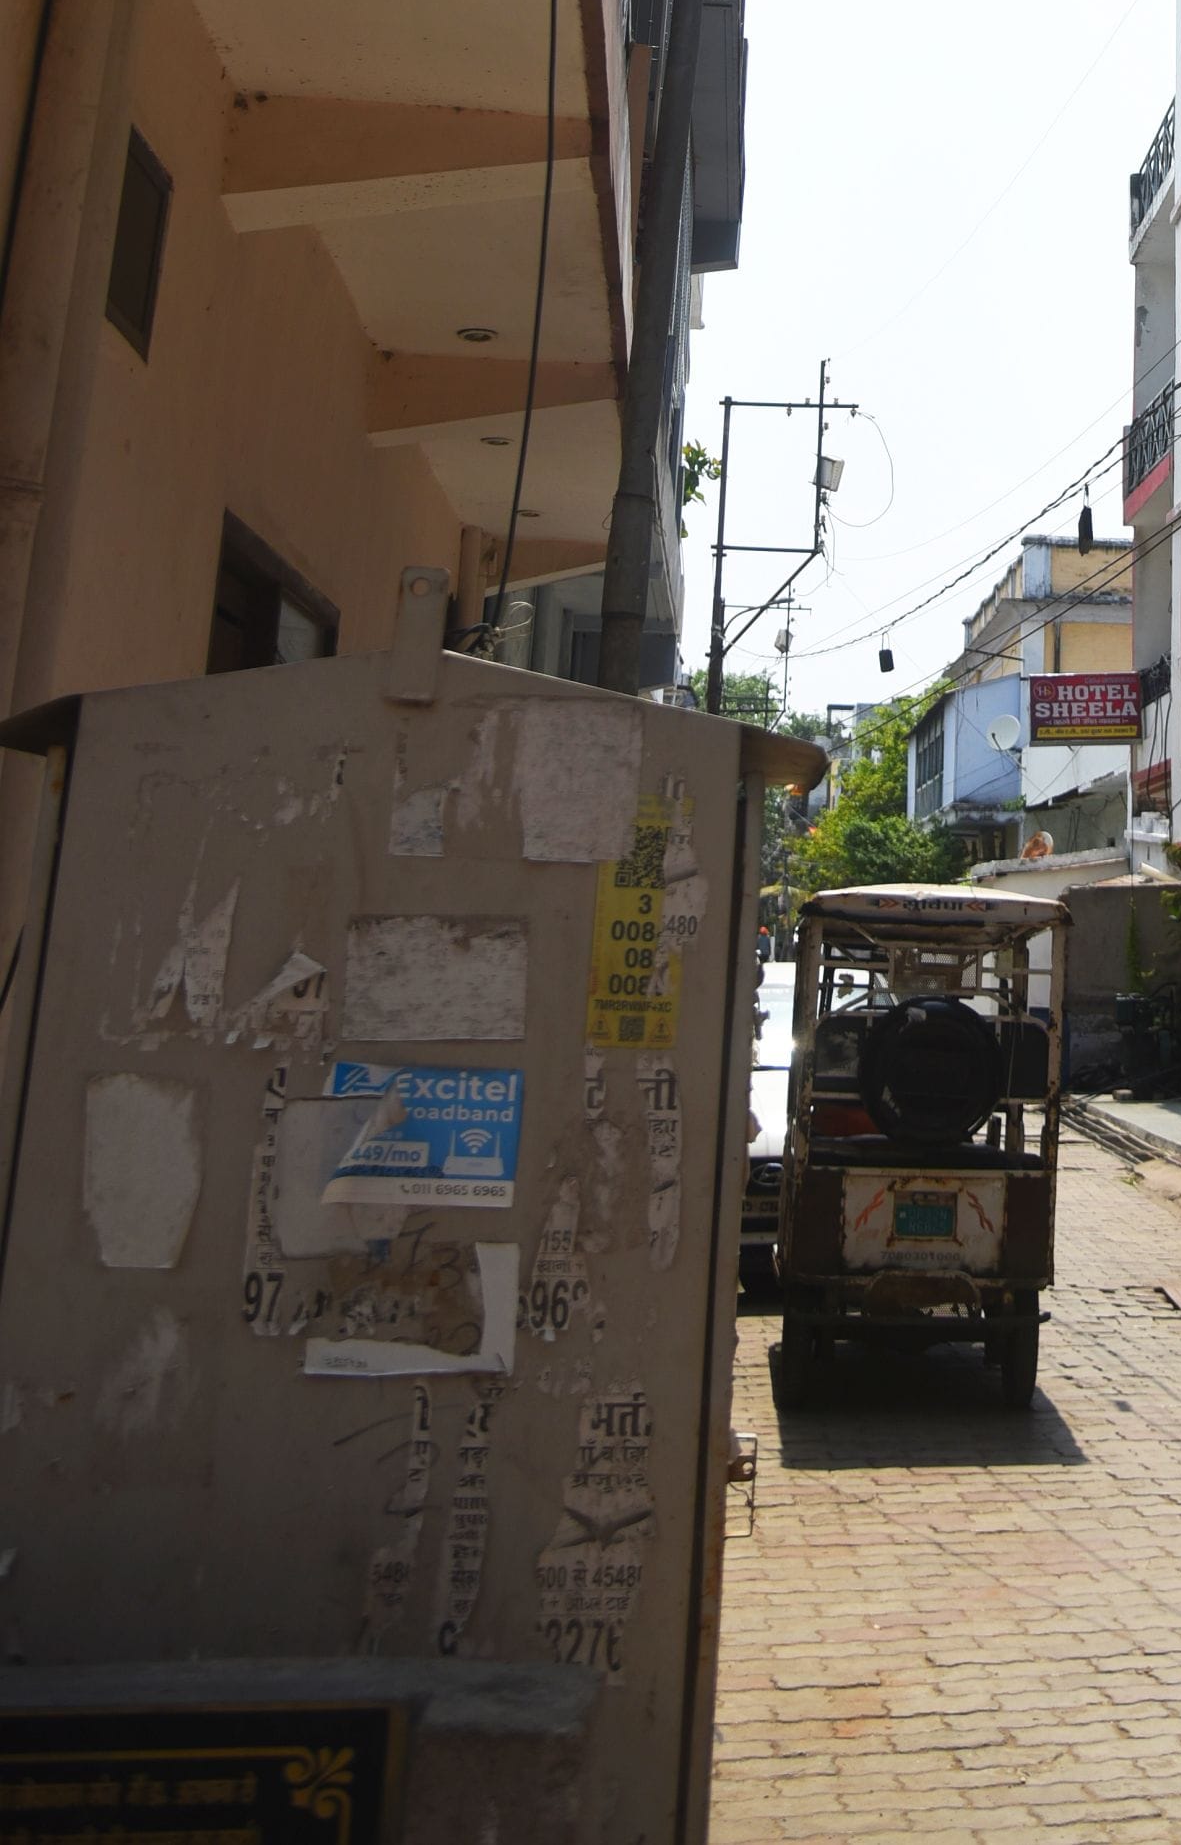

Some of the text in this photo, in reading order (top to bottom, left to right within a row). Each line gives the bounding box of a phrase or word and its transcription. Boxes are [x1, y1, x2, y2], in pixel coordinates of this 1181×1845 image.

[1057, 684, 1137, 701] HOTEL
[1034, 701, 1137, 717] SHEELA
[638, 893, 653, 915] 3
[395, 1071, 518, 1102] Excitel
[405, 1105, 514, 1123] roadband
[412, 1183, 506, 1197] 011 6965 6965
